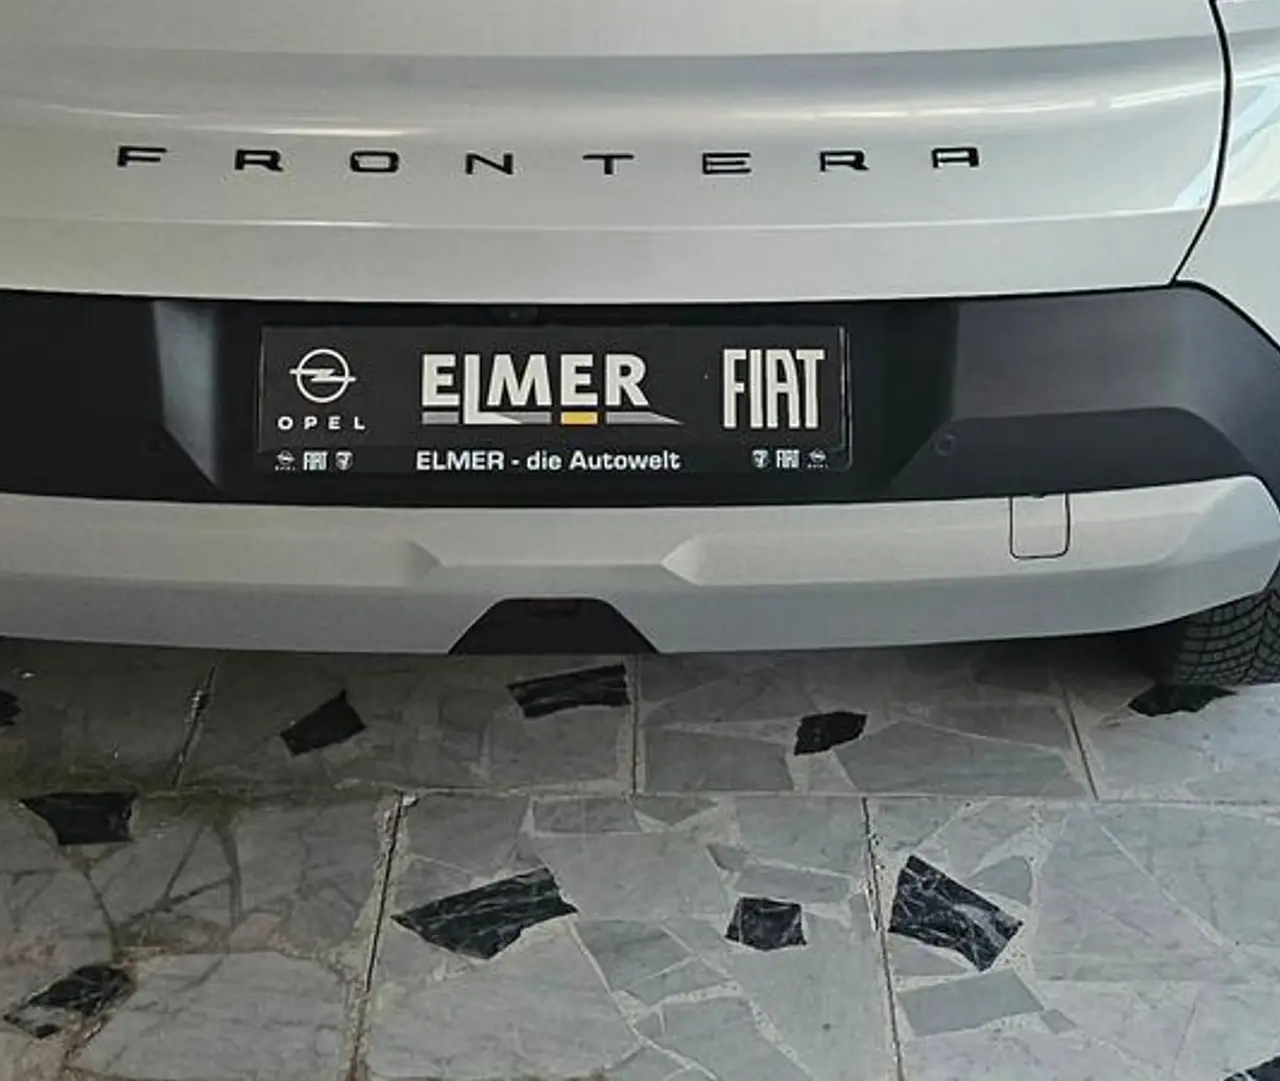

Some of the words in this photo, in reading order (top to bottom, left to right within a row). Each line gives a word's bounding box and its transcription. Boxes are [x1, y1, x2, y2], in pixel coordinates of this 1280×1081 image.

[117, 145, 979, 175] FRONTERA
[422, 354, 650, 425] ELMER
[723, 349, 825, 429] FIAT
[276, 415, 366, 431] OPEL
[416, 450, 505, 471] ELMER
[526, 449, 562, 471] die
[569, 449, 681, 471] Autowelt
